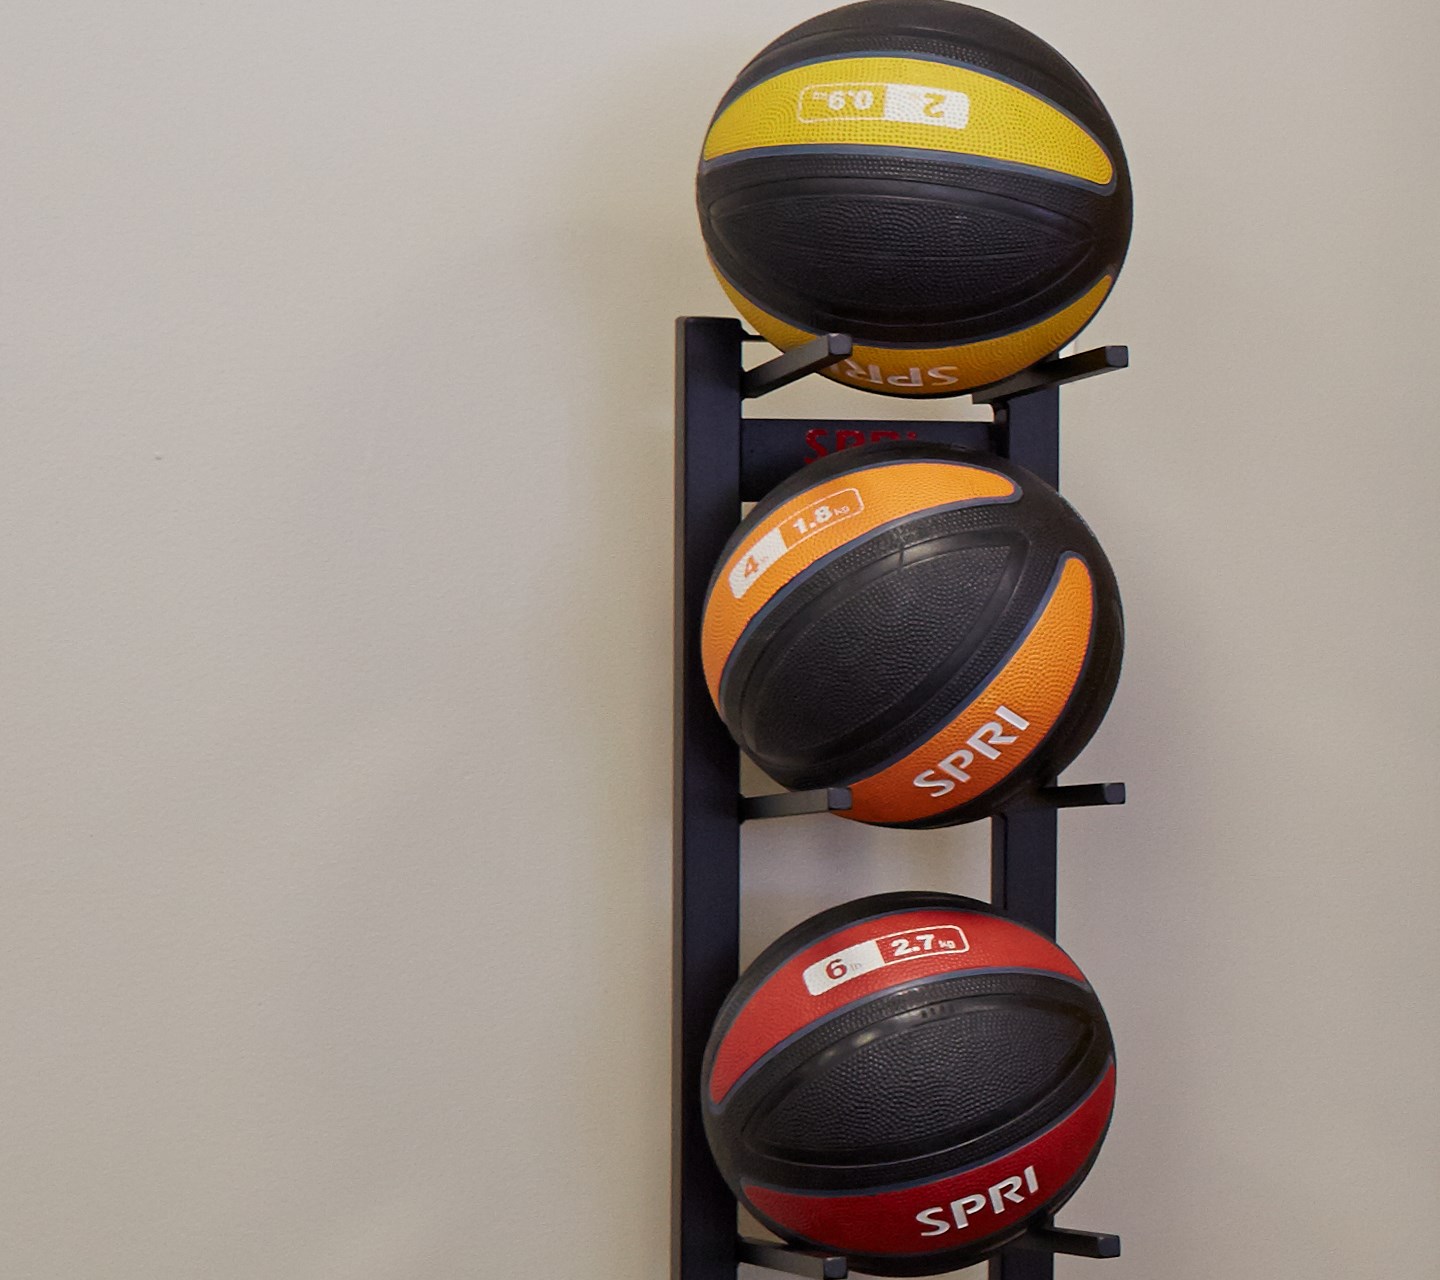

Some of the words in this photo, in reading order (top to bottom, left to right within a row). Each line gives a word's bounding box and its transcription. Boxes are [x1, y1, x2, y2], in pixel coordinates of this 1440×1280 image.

[827, 90, 874, 111] 0.9
[923, 92, 946, 119] 2
[829, 358, 959, 387] SPR
[804, 428, 918, 464] SP
[744, 555, 759, 578] 4
[793, 505, 832, 534] 1.8
[912, 705, 1030, 797] SPRI
[825, 958, 848, 980] 6
[891, 934, 934, 957] 2.7
[915, 1165, 1039, 1237] SPRI
